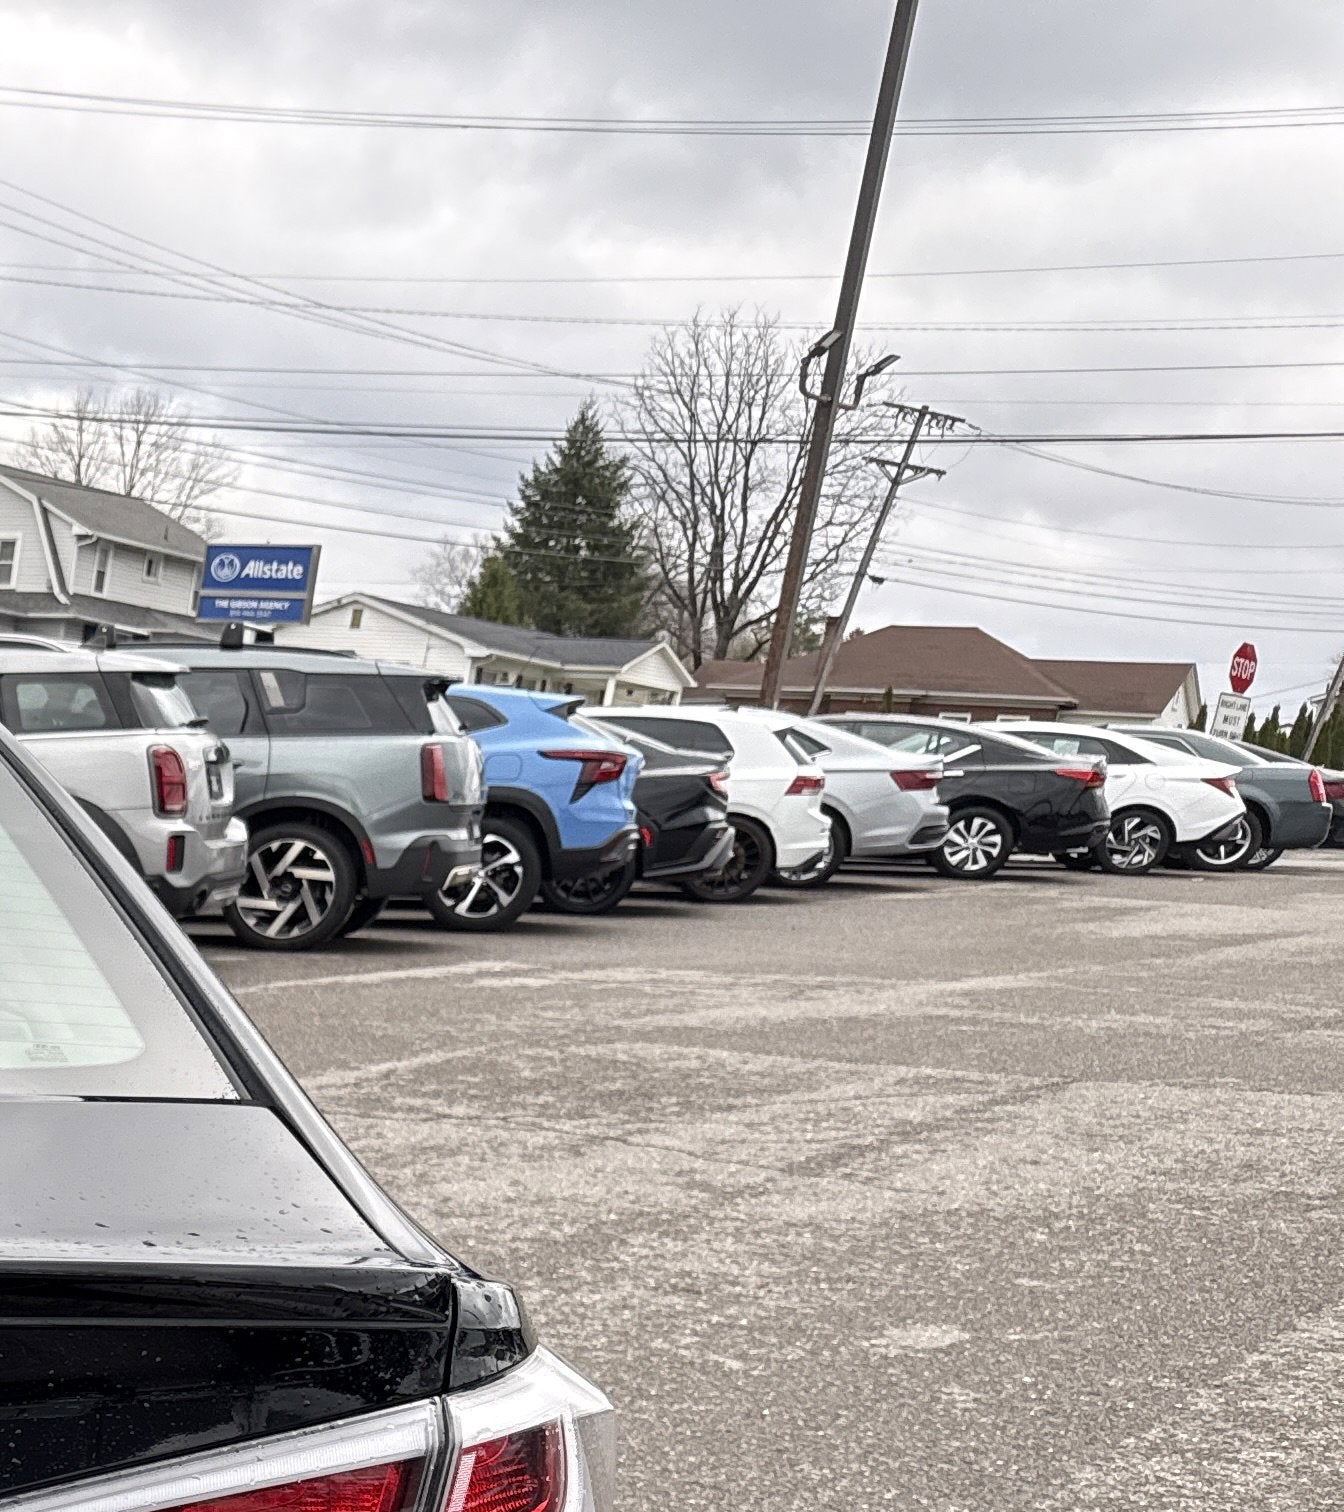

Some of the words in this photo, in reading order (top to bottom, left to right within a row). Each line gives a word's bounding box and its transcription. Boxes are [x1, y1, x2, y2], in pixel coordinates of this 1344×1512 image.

[240, 560, 304, 580] Allstate
[1231, 656, 1255, 680] STOP
[1223, 714, 1241, 727] MUST
